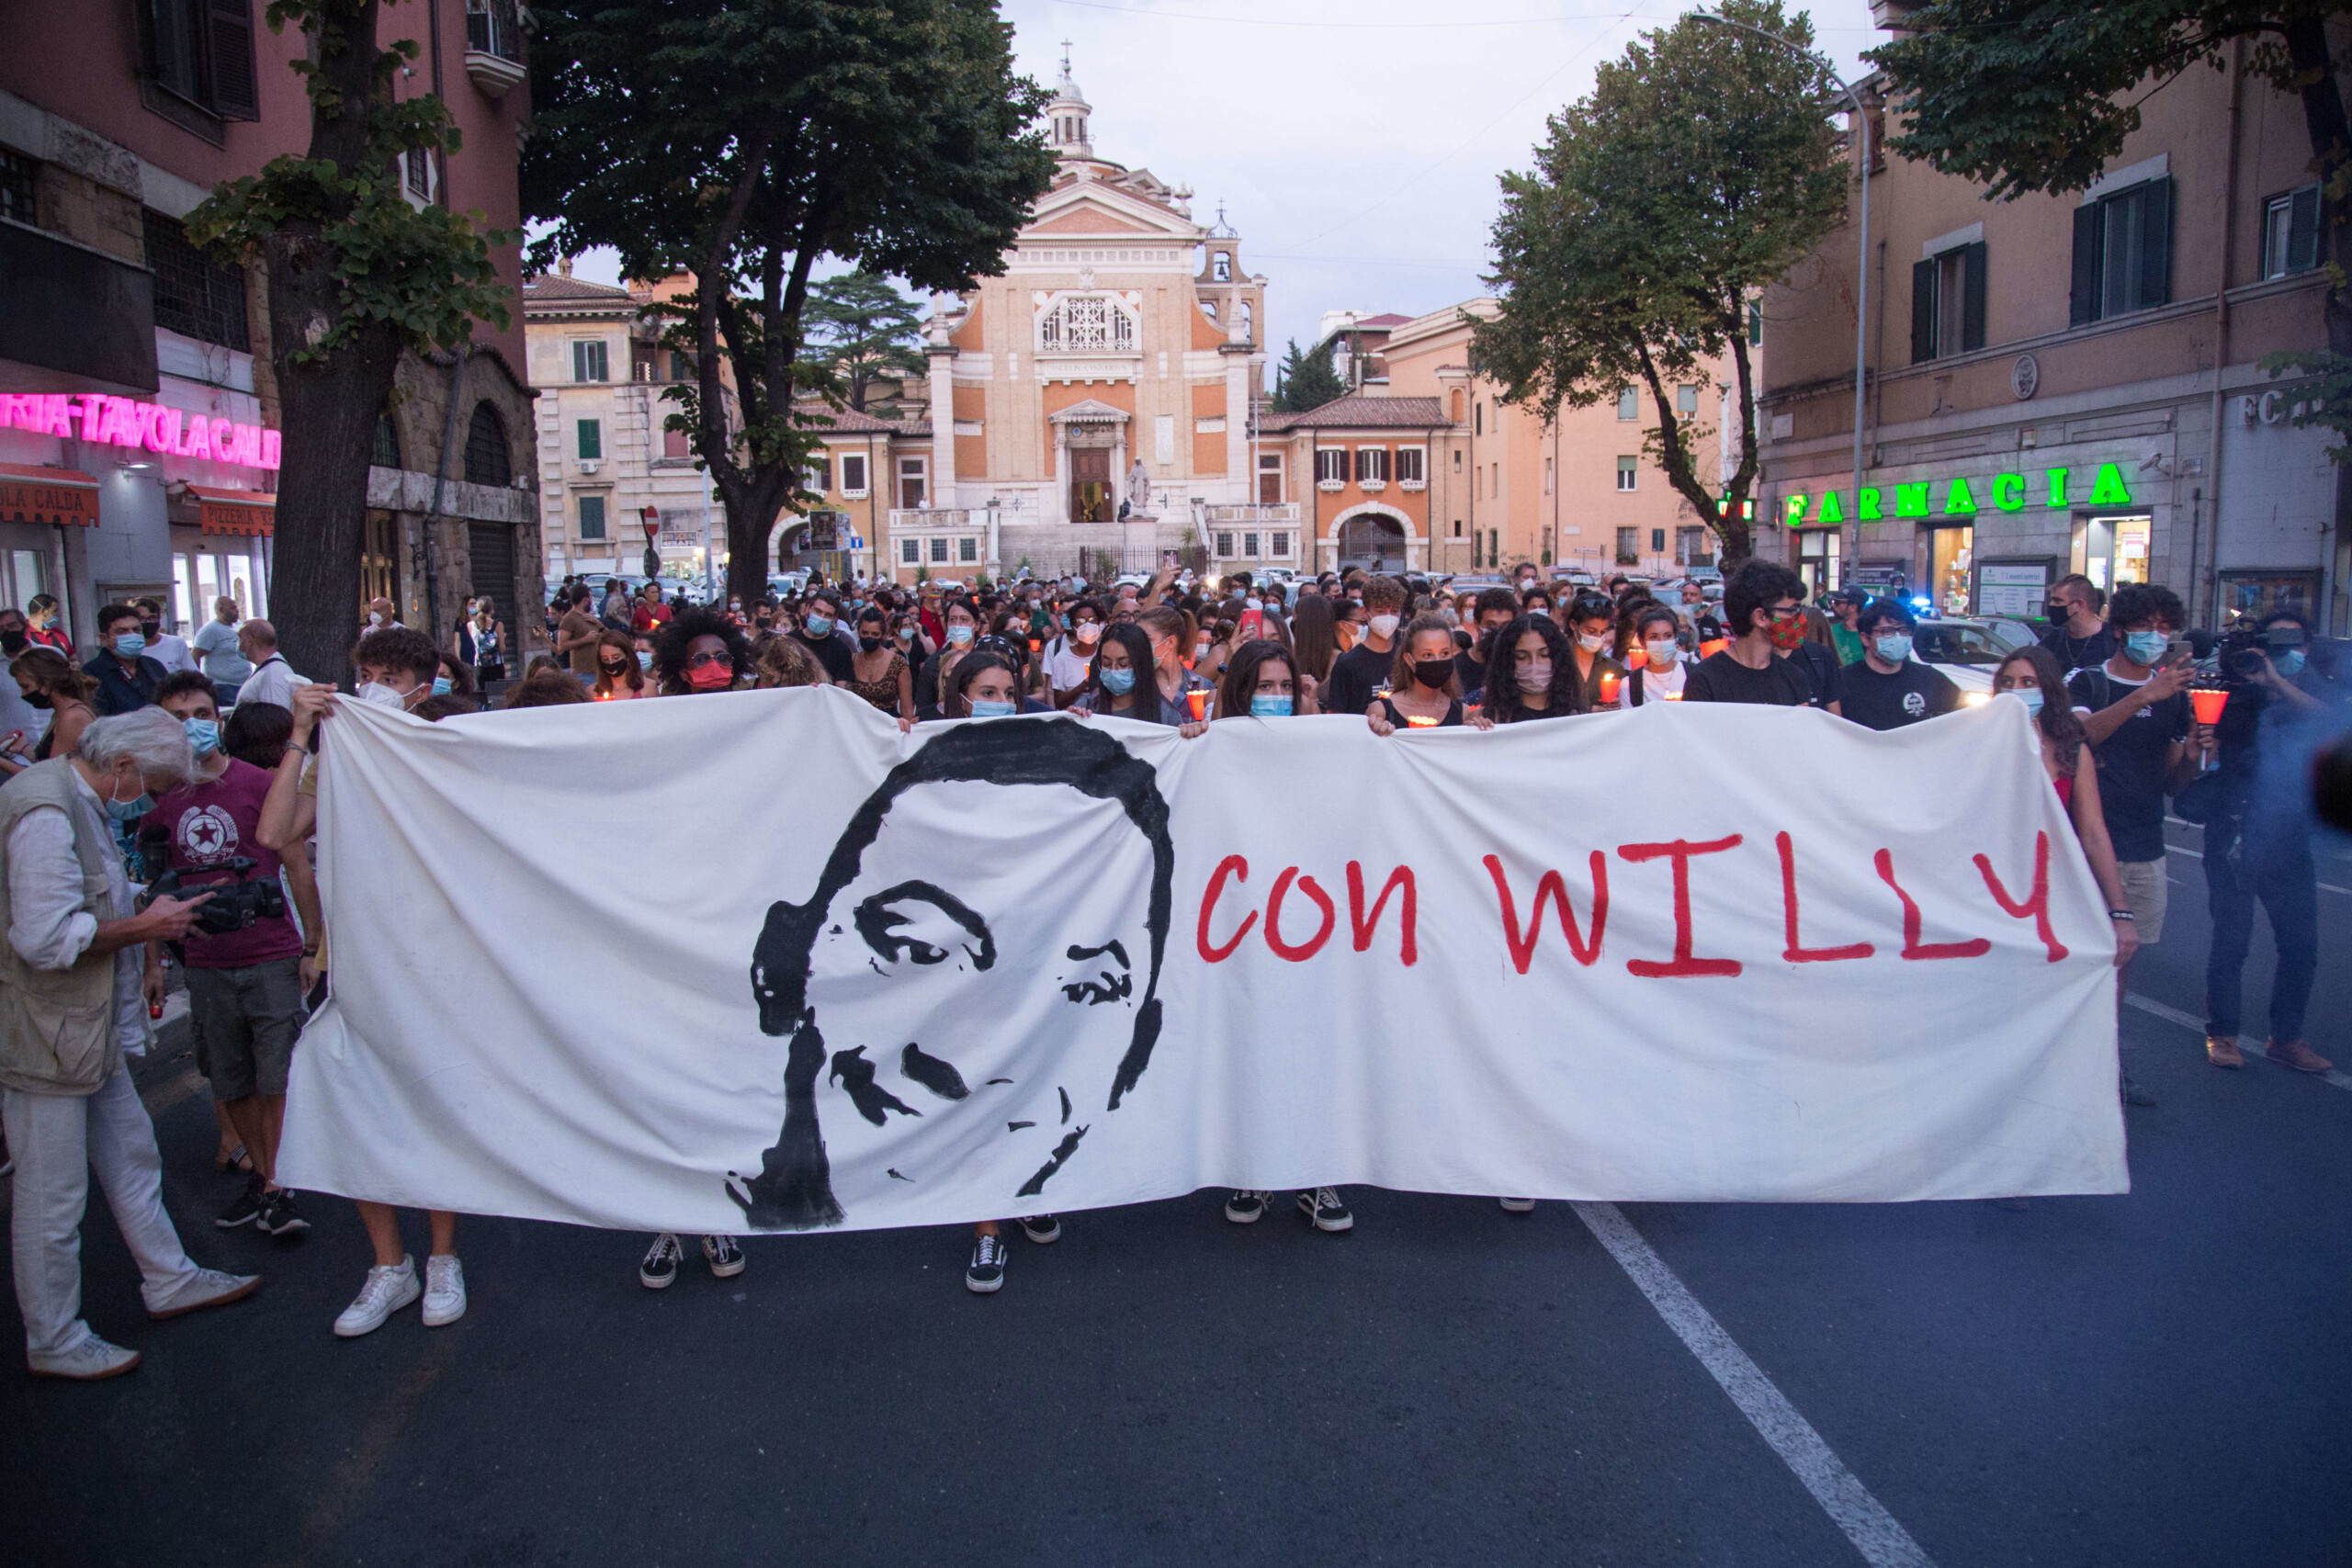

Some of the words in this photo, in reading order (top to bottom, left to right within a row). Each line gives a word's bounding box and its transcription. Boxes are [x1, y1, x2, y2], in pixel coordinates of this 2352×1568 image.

[35, 490, 84, 511] CALDA
[1787, 463, 2130, 525] FARMACIA
[208, 506, 254, 525] PIZZERIA
[1483, 831, 2068, 977] WILLY
